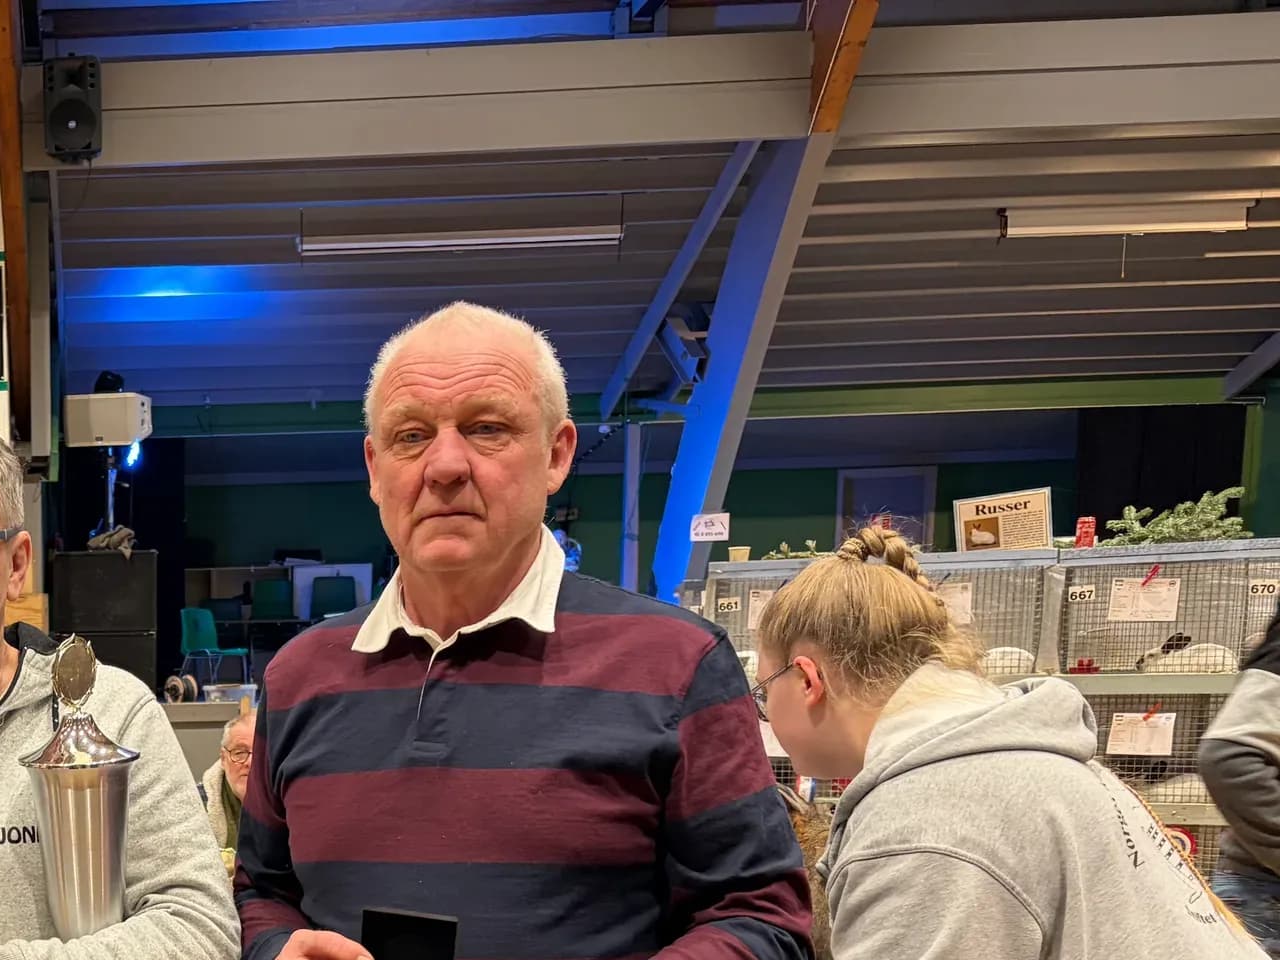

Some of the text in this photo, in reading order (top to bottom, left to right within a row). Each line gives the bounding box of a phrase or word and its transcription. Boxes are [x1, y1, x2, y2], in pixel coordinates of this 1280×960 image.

[974, 500, 1031, 516] Russer
[1250, 584, 1276, 595] 670
[1070, 590, 1094, 601] 667
[719, 602, 738, 611] 661
